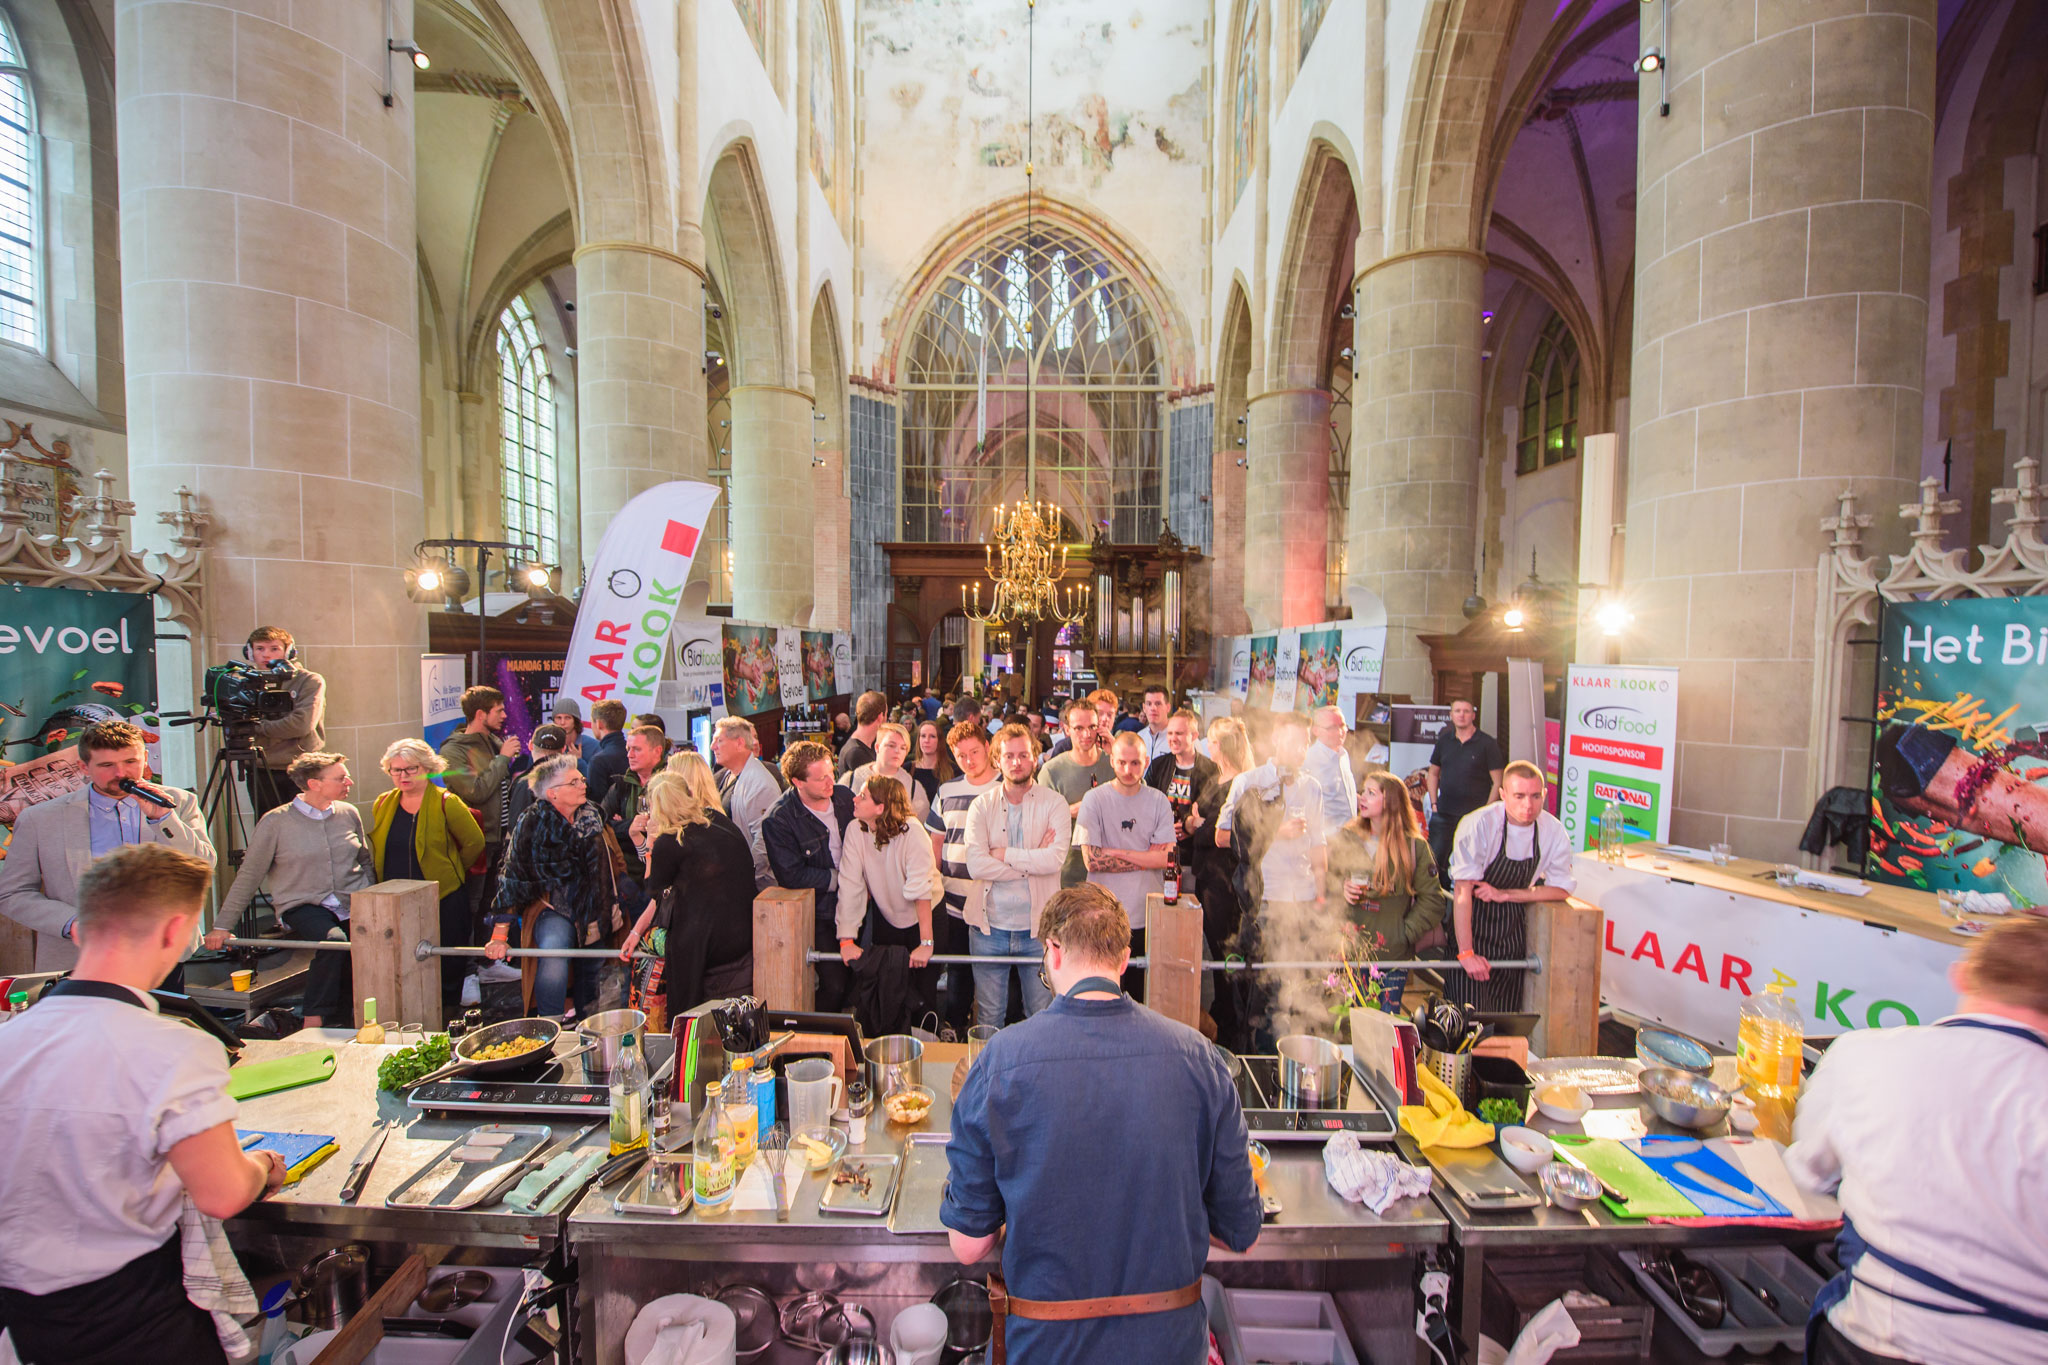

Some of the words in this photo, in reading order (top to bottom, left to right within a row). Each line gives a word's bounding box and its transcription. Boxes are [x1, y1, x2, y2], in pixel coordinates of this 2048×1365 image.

[0, 617, 133, 654] evoel
[624, 578, 682, 697] KOOK
[784, 637, 796, 651] Het
[1903, 624, 1984, 664] Het
[2001, 623, 2048, 666] Bi
[507, 660, 541, 672] MAANDAG
[543, 660, 552, 671] 16
[1573, 676, 1611, 689] KLAAR
[1620, 680, 1657, 692] KOOK
[1595, 713, 1657, 736] Bidfood
[1582, 742, 1646, 760] HOOFDSPONSOR
[1595, 784, 1651, 809] RATIONAL
